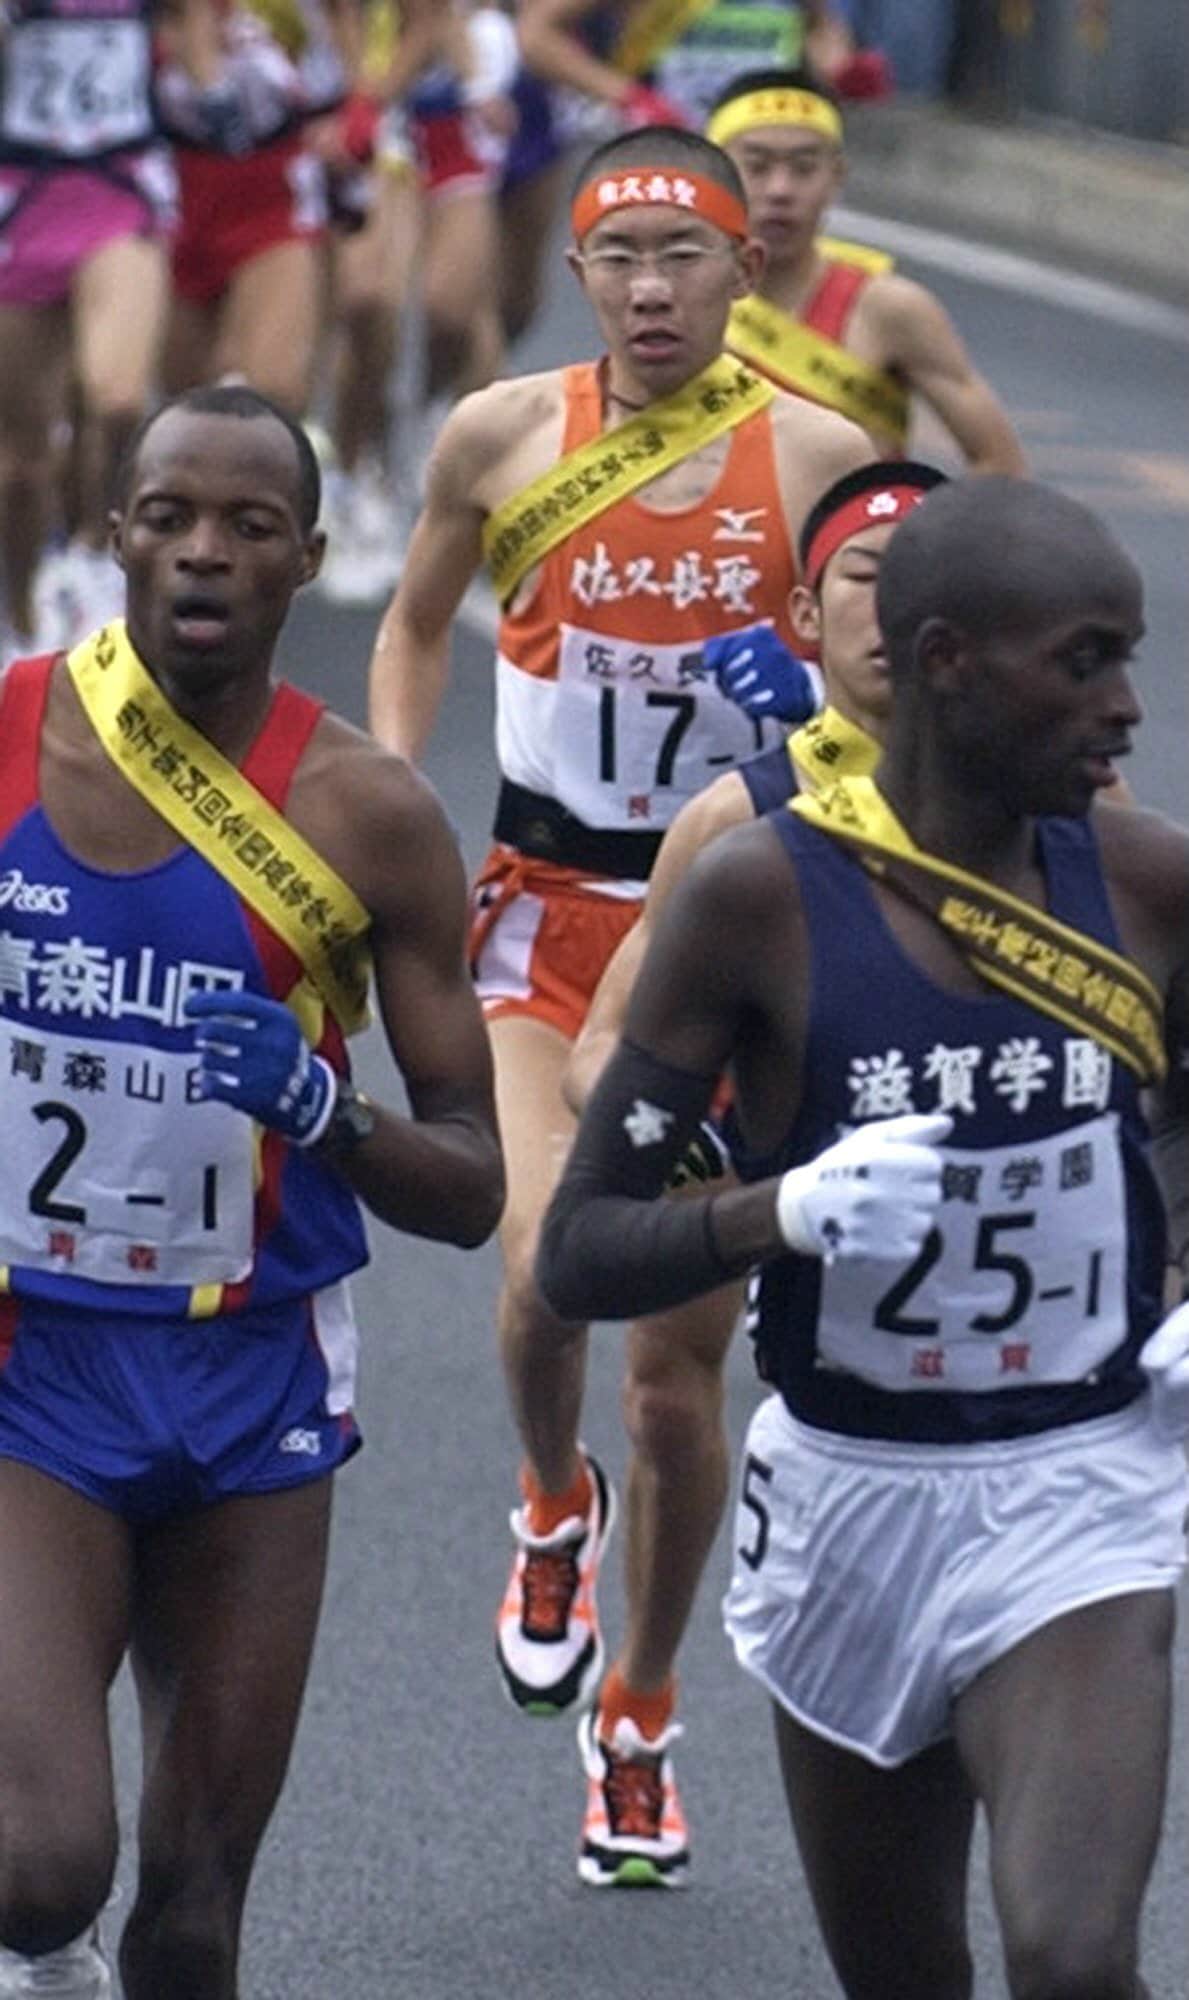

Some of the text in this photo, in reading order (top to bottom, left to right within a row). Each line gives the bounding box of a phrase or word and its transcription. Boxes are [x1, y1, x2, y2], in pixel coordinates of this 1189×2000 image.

[569, 541, 762, 615] 佐久長聖
[846, 1037, 1111, 1118] 滋賀学園
[29, 1100, 217, 1230] 2-1
[873, 1211, 1102, 1335] 25-1
